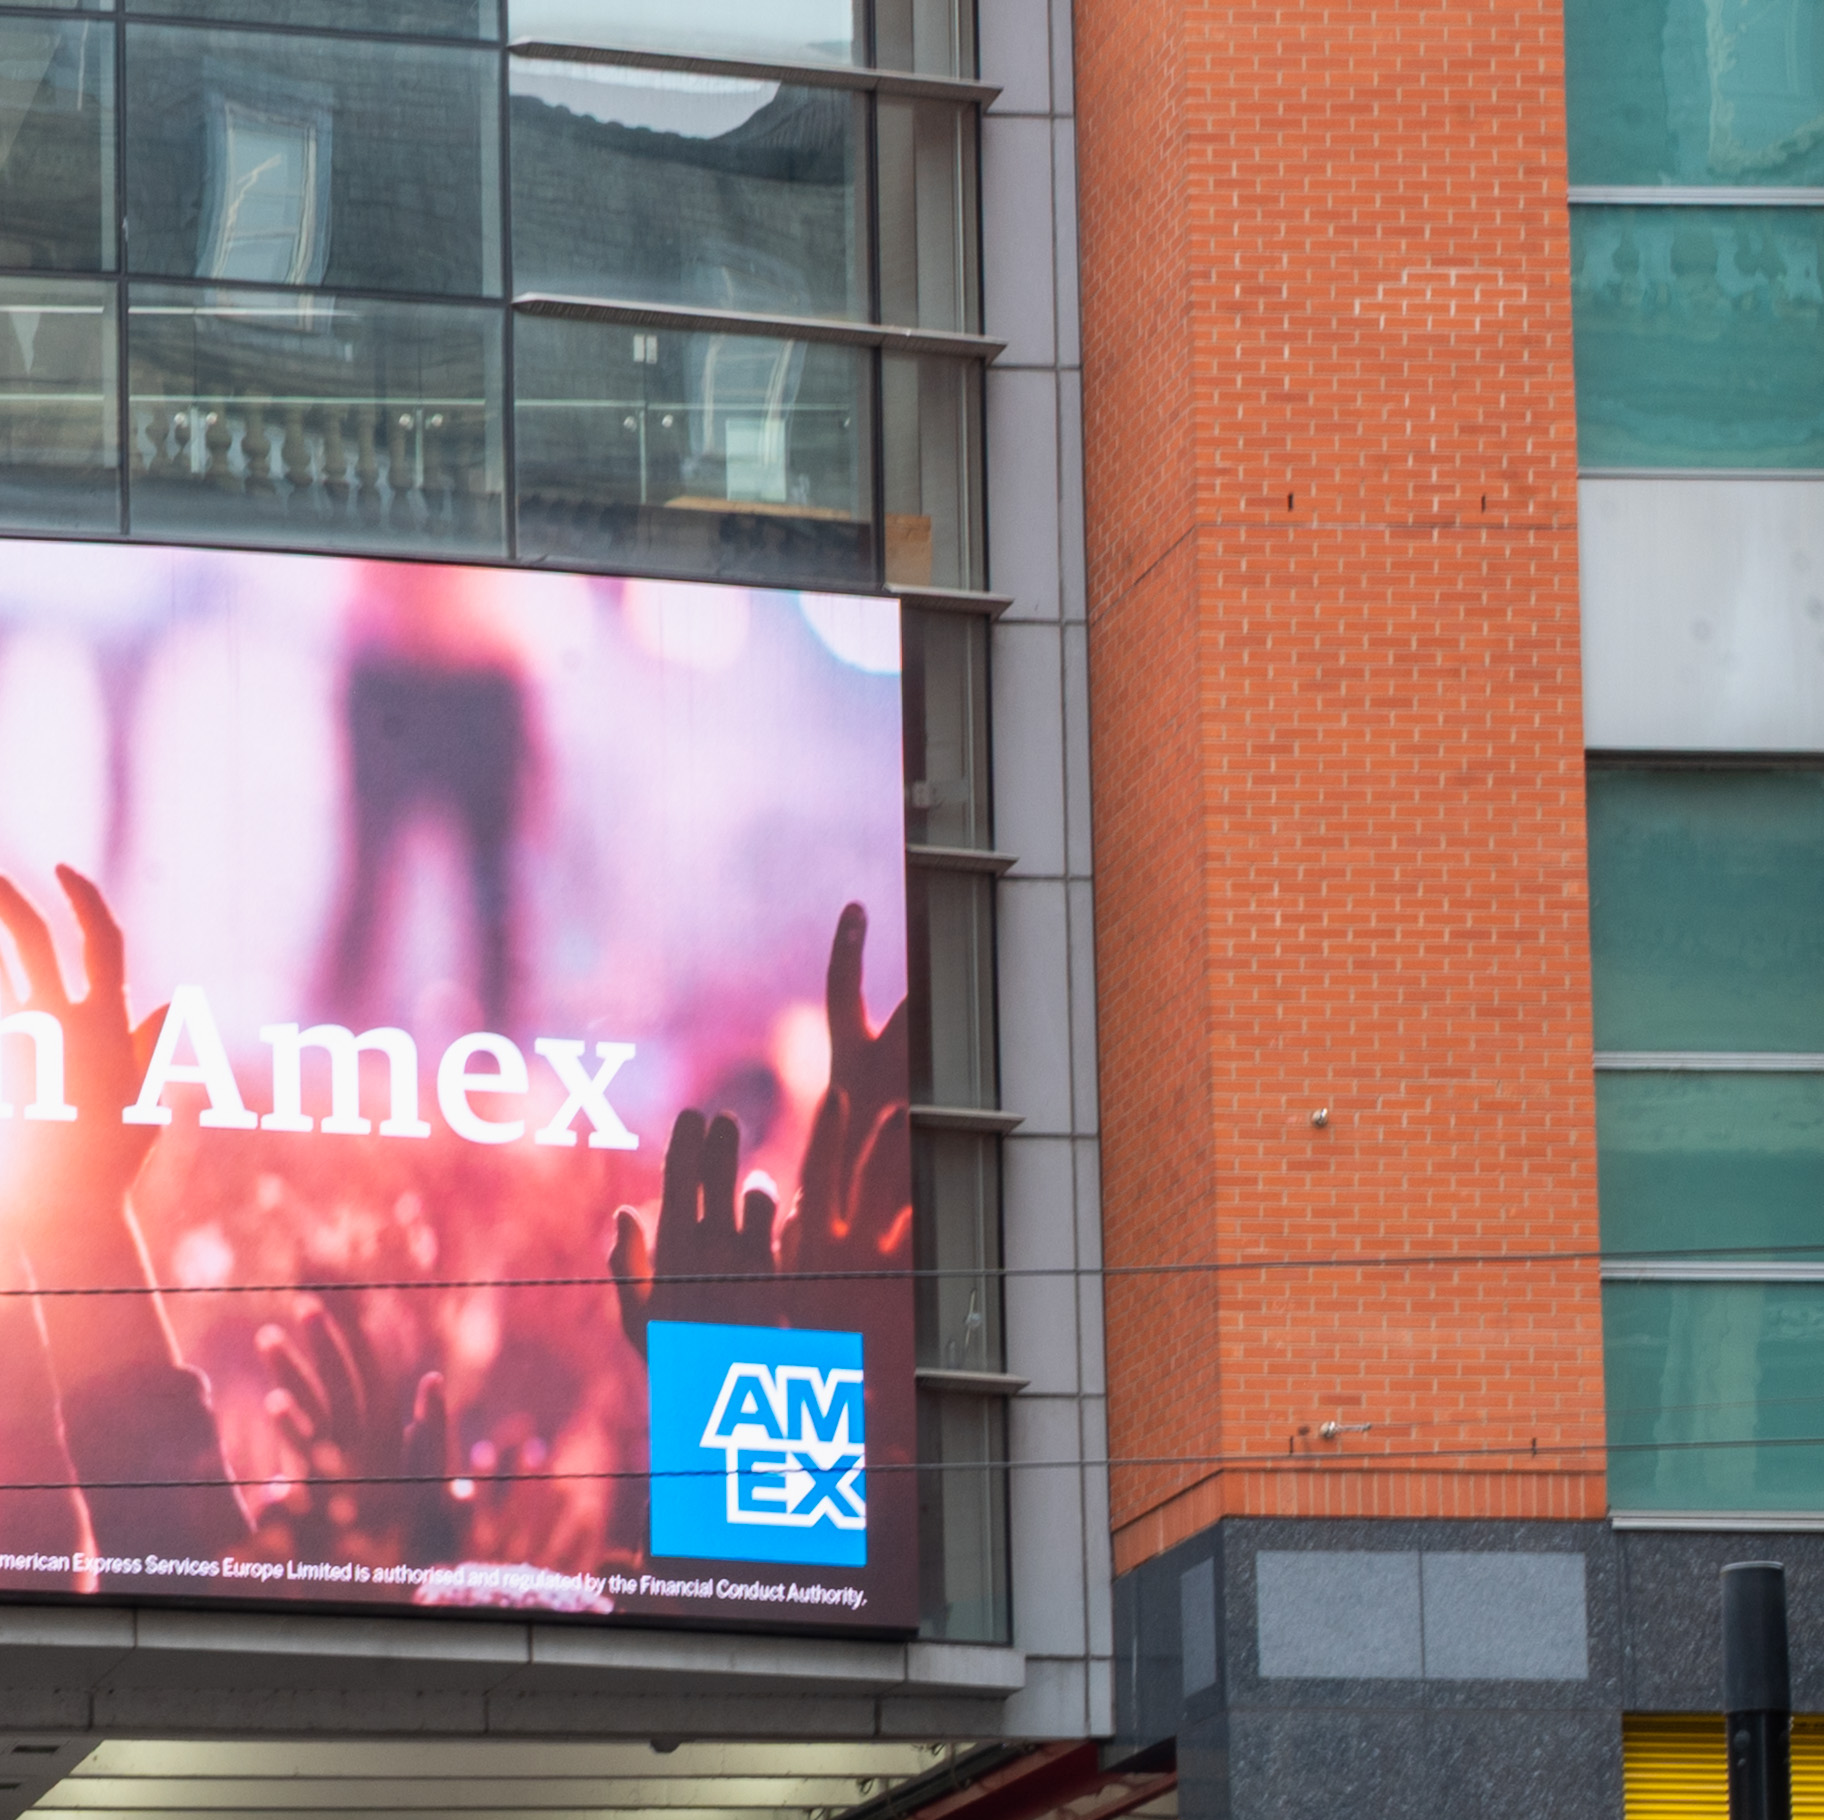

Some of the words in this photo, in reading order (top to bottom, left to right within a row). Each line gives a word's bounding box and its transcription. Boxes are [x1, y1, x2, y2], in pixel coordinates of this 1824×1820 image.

[122, 984, 639, 1149] Amex
[73, 1552, 142, 1576] Express
[145, 1555, 219, 1577] Services
[222, 1557, 284, 1582] Europe
[287, 1560, 352, 1582] Limited
[355, 1562, 370, 1582] is
[373, 1563, 464, 1586] authorised
[468, 1568, 499, 1587] and
[502, 1570, 583, 1593] regulated
[585, 1573, 607, 1595] by
[609, 1574, 637, 1595] the
[640, 1575, 713, 1598] Financial
[716, 1579, 784, 1602] Conduct
